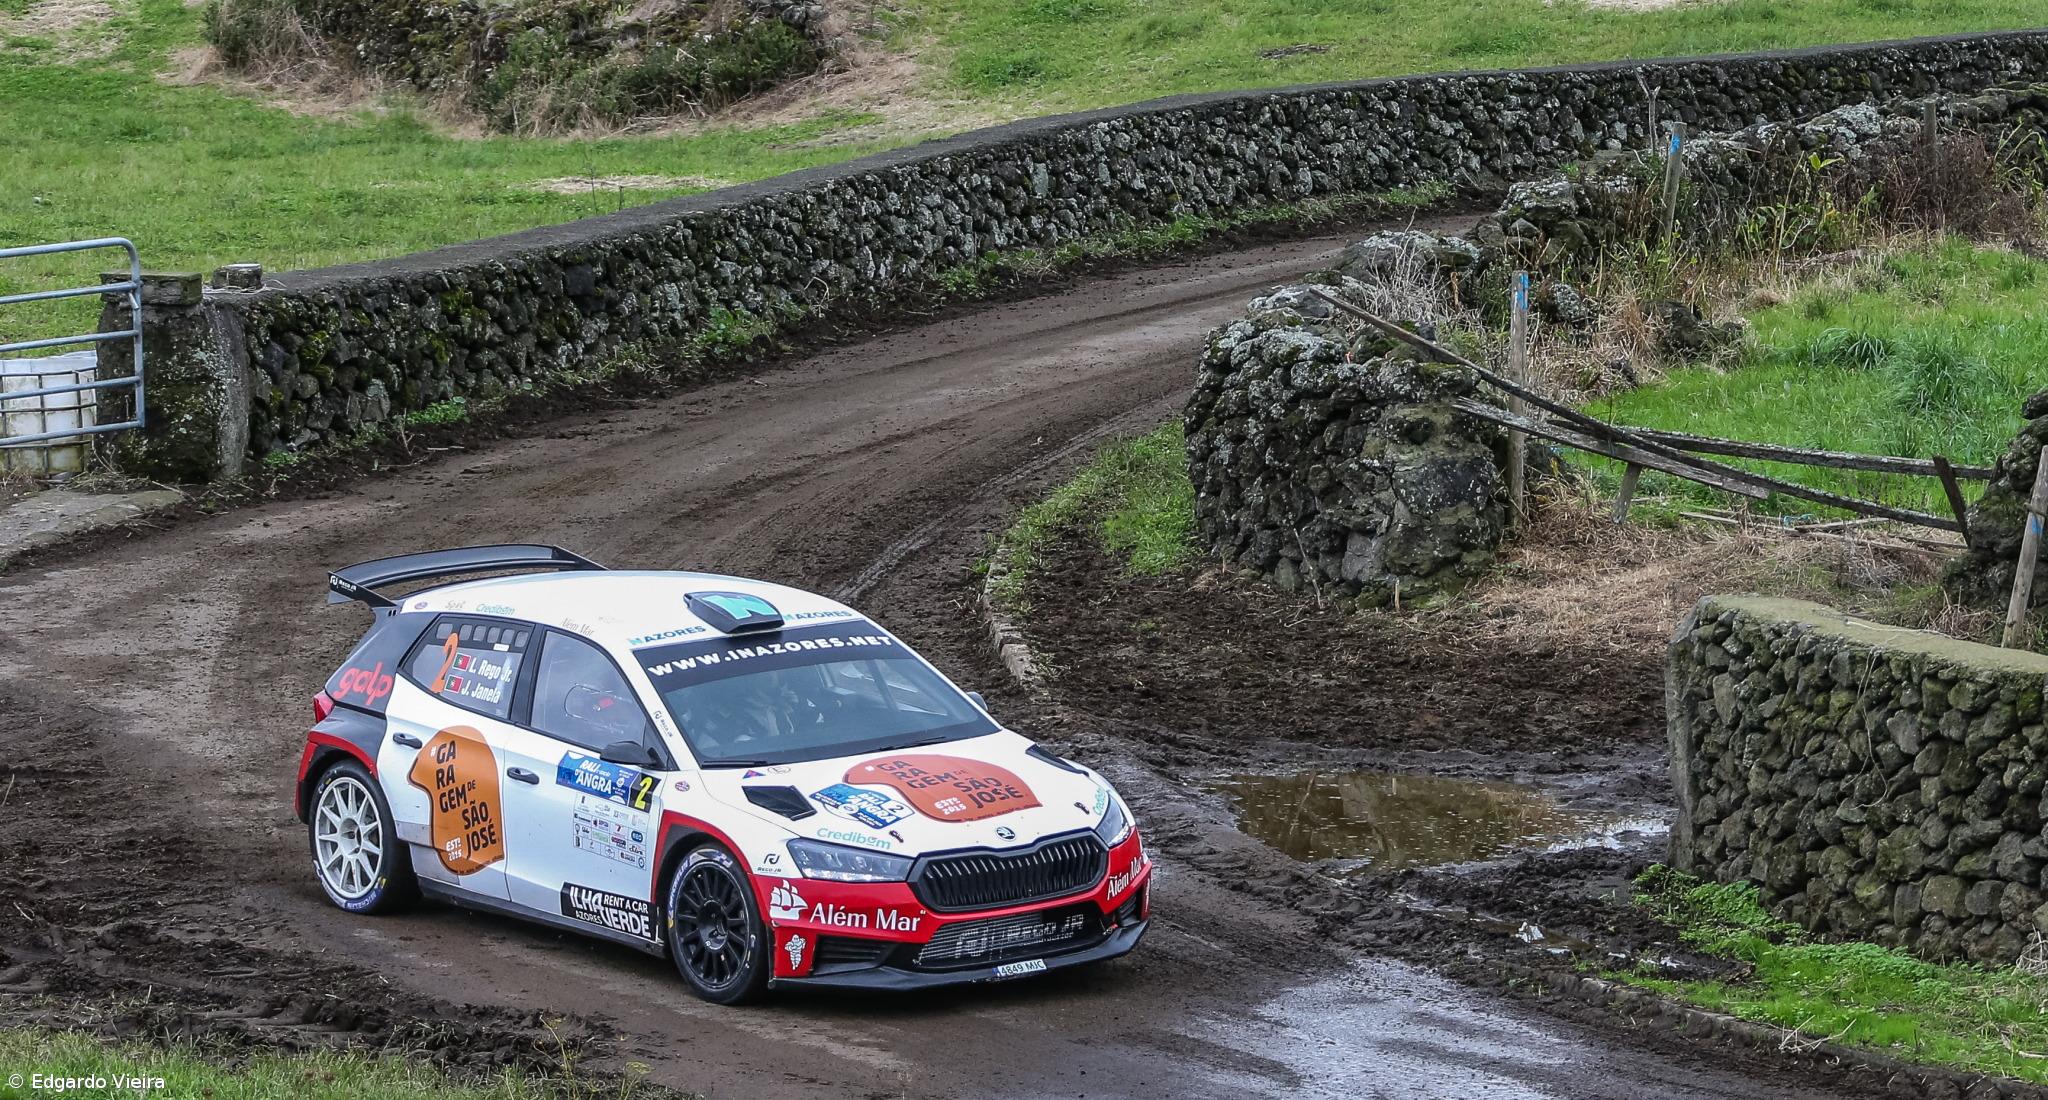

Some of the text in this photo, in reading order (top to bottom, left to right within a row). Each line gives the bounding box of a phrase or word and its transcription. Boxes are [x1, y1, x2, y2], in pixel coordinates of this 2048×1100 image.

[648, 635, 894, 678] WWW.INAZORES.NET
[468, 656, 513, 683] L. Rego Jr.
[332, 661, 394, 706] galp
[461, 680, 500, 704] J. Janela
[435, 764, 455, 790] RA
[579, 760, 601, 773] RALI
[890, 767, 929, 781] RA
[633, 776, 653, 810] 2
[905, 772, 958, 790] GEM
[953, 777, 1003, 793] SÃO
[439, 779, 476, 813] GEM DE
[888, 804, 904, 813] 2
[967, 784, 1025, 809] JOSÉ
[461, 799, 489, 830] SÃO
[943, 803, 968, 816] 2015
[465, 818, 497, 860] JOSÉ
[816, 827, 891, 850] Credibom
[569, 886, 649, 914] ILHA RENT A CAR
[575, 910, 603, 926] AZORES
[809, 902, 868, 929] Além
[1000, 960, 1046, 978] 4849 MJC
